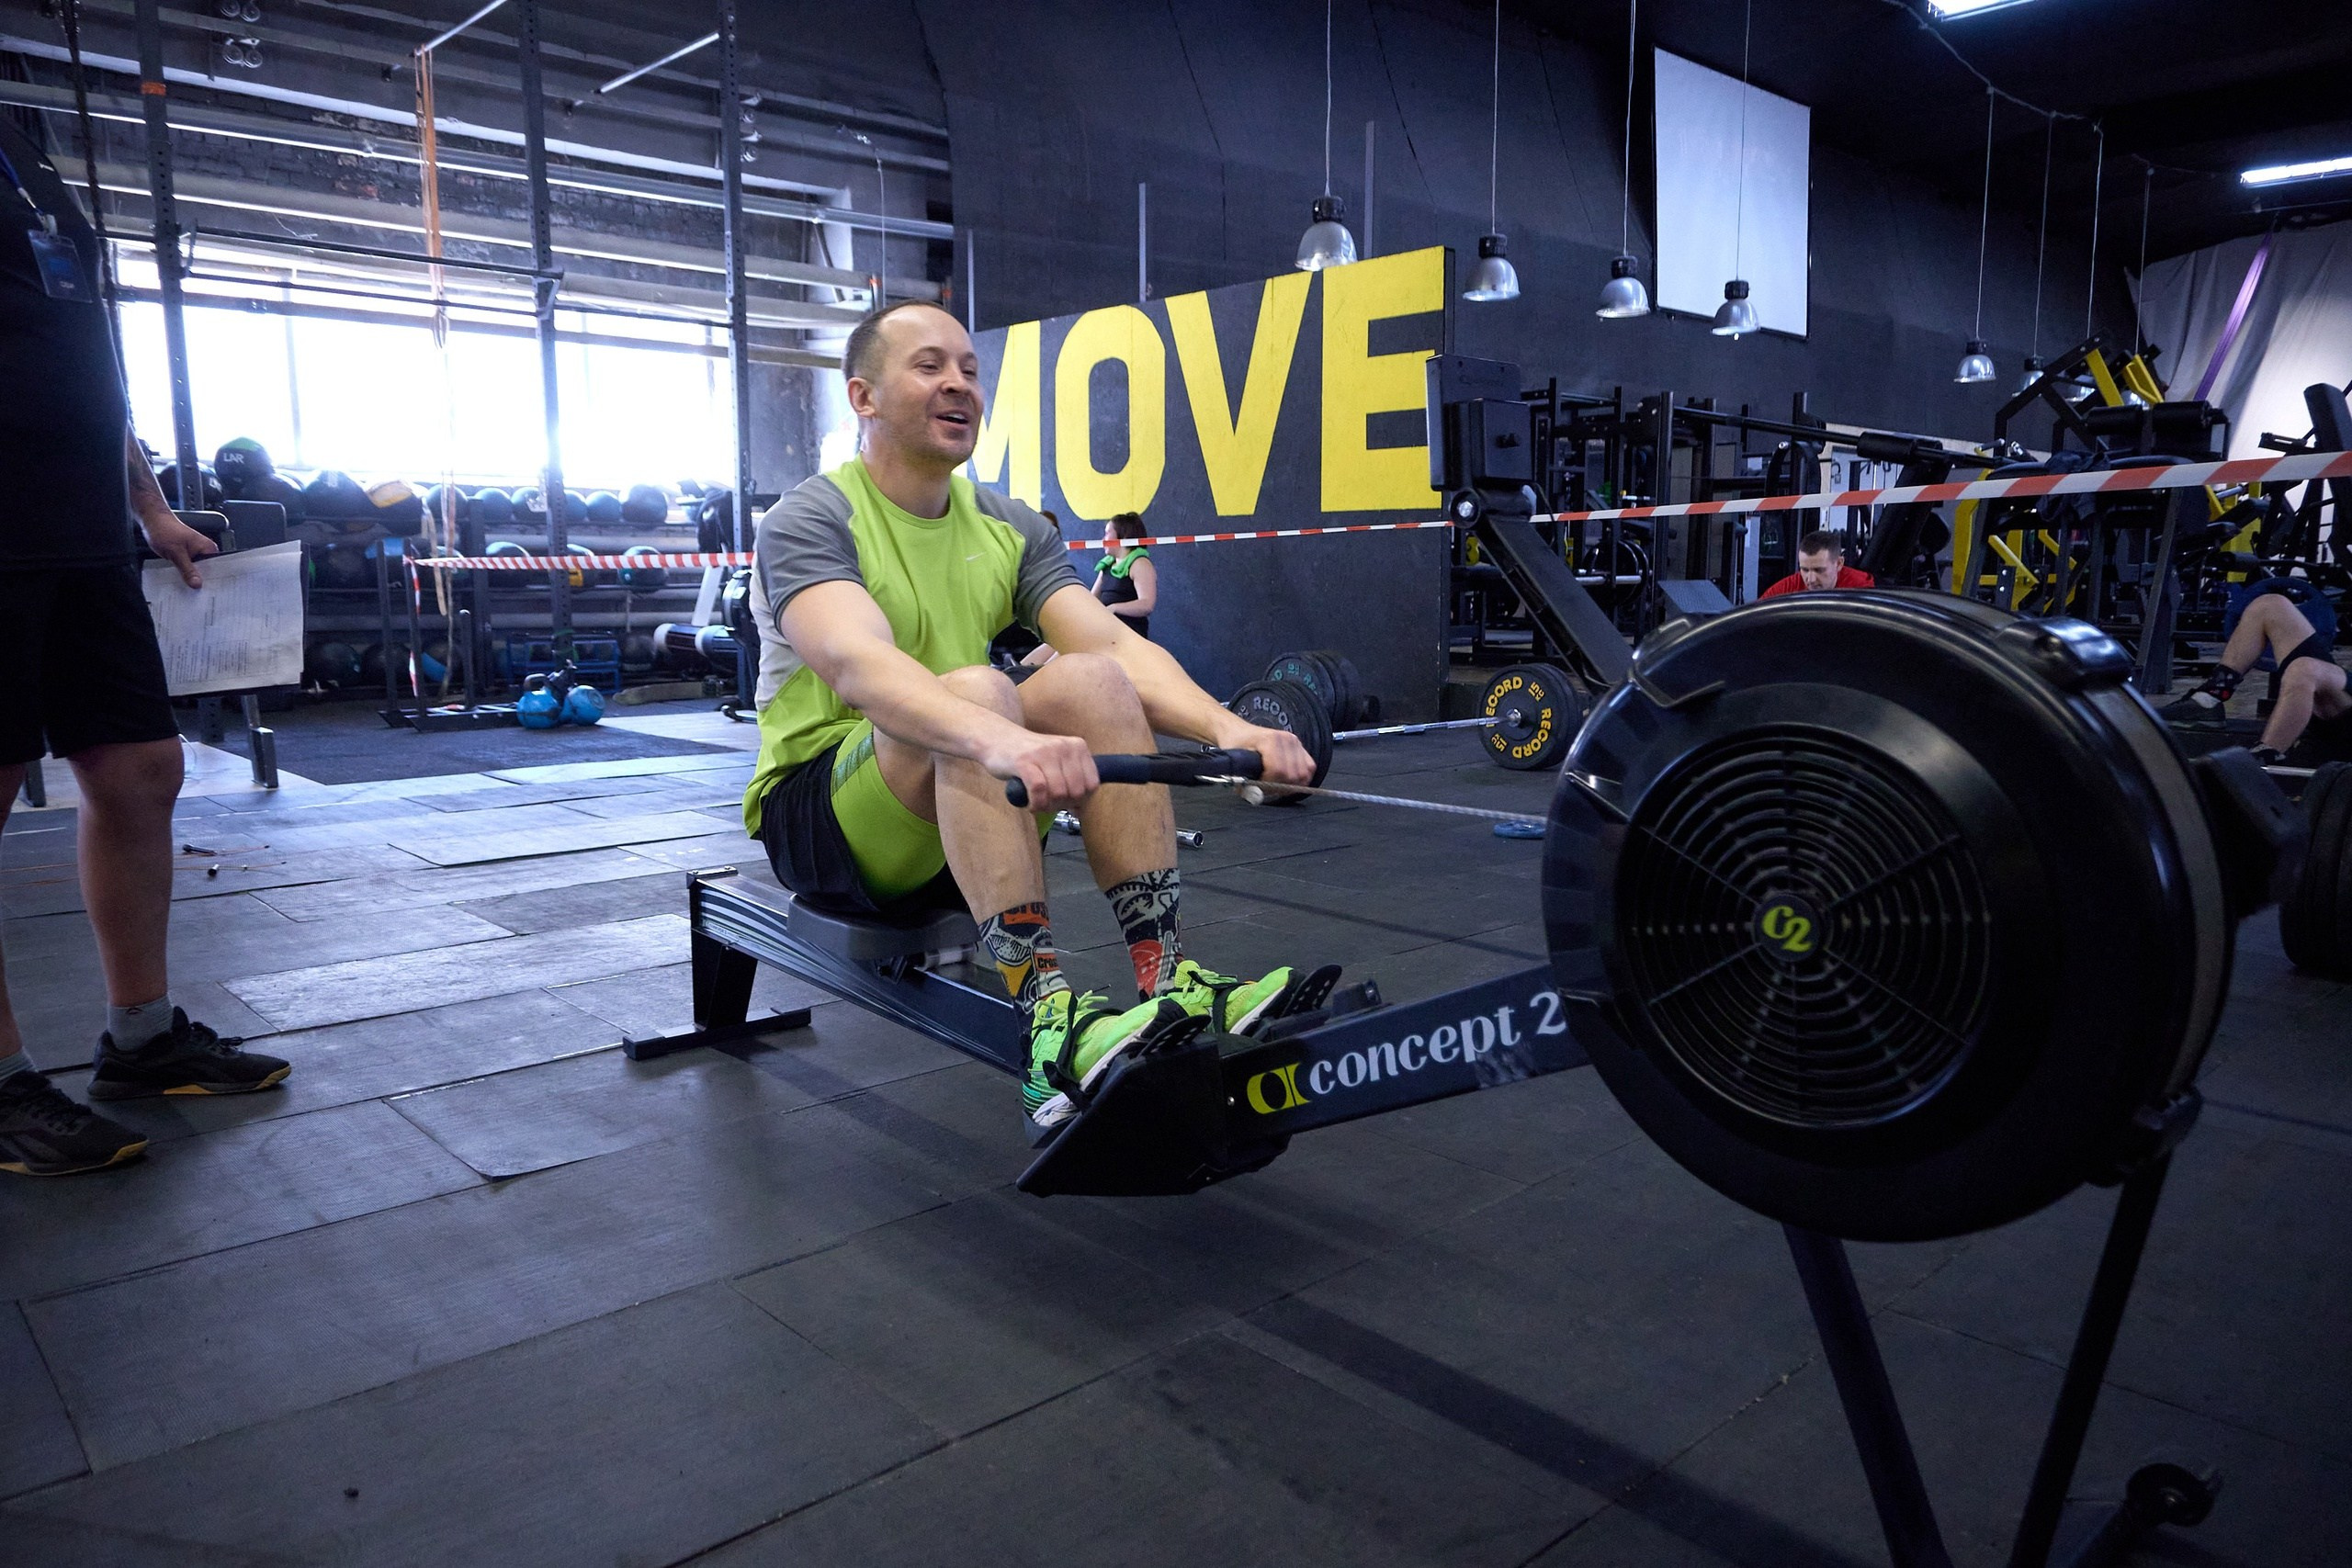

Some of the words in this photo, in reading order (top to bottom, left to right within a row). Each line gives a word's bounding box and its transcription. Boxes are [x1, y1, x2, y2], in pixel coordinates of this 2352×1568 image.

[952, 245, 1444, 520] MOVE
[1528, 682, 1540, 697] 15
[1511, 707, 1552, 759] RECORD
[1762, 906, 1813, 952] C2
[1309, 1006, 1521, 1095] concept
[1530, 991, 1566, 1035] 2
